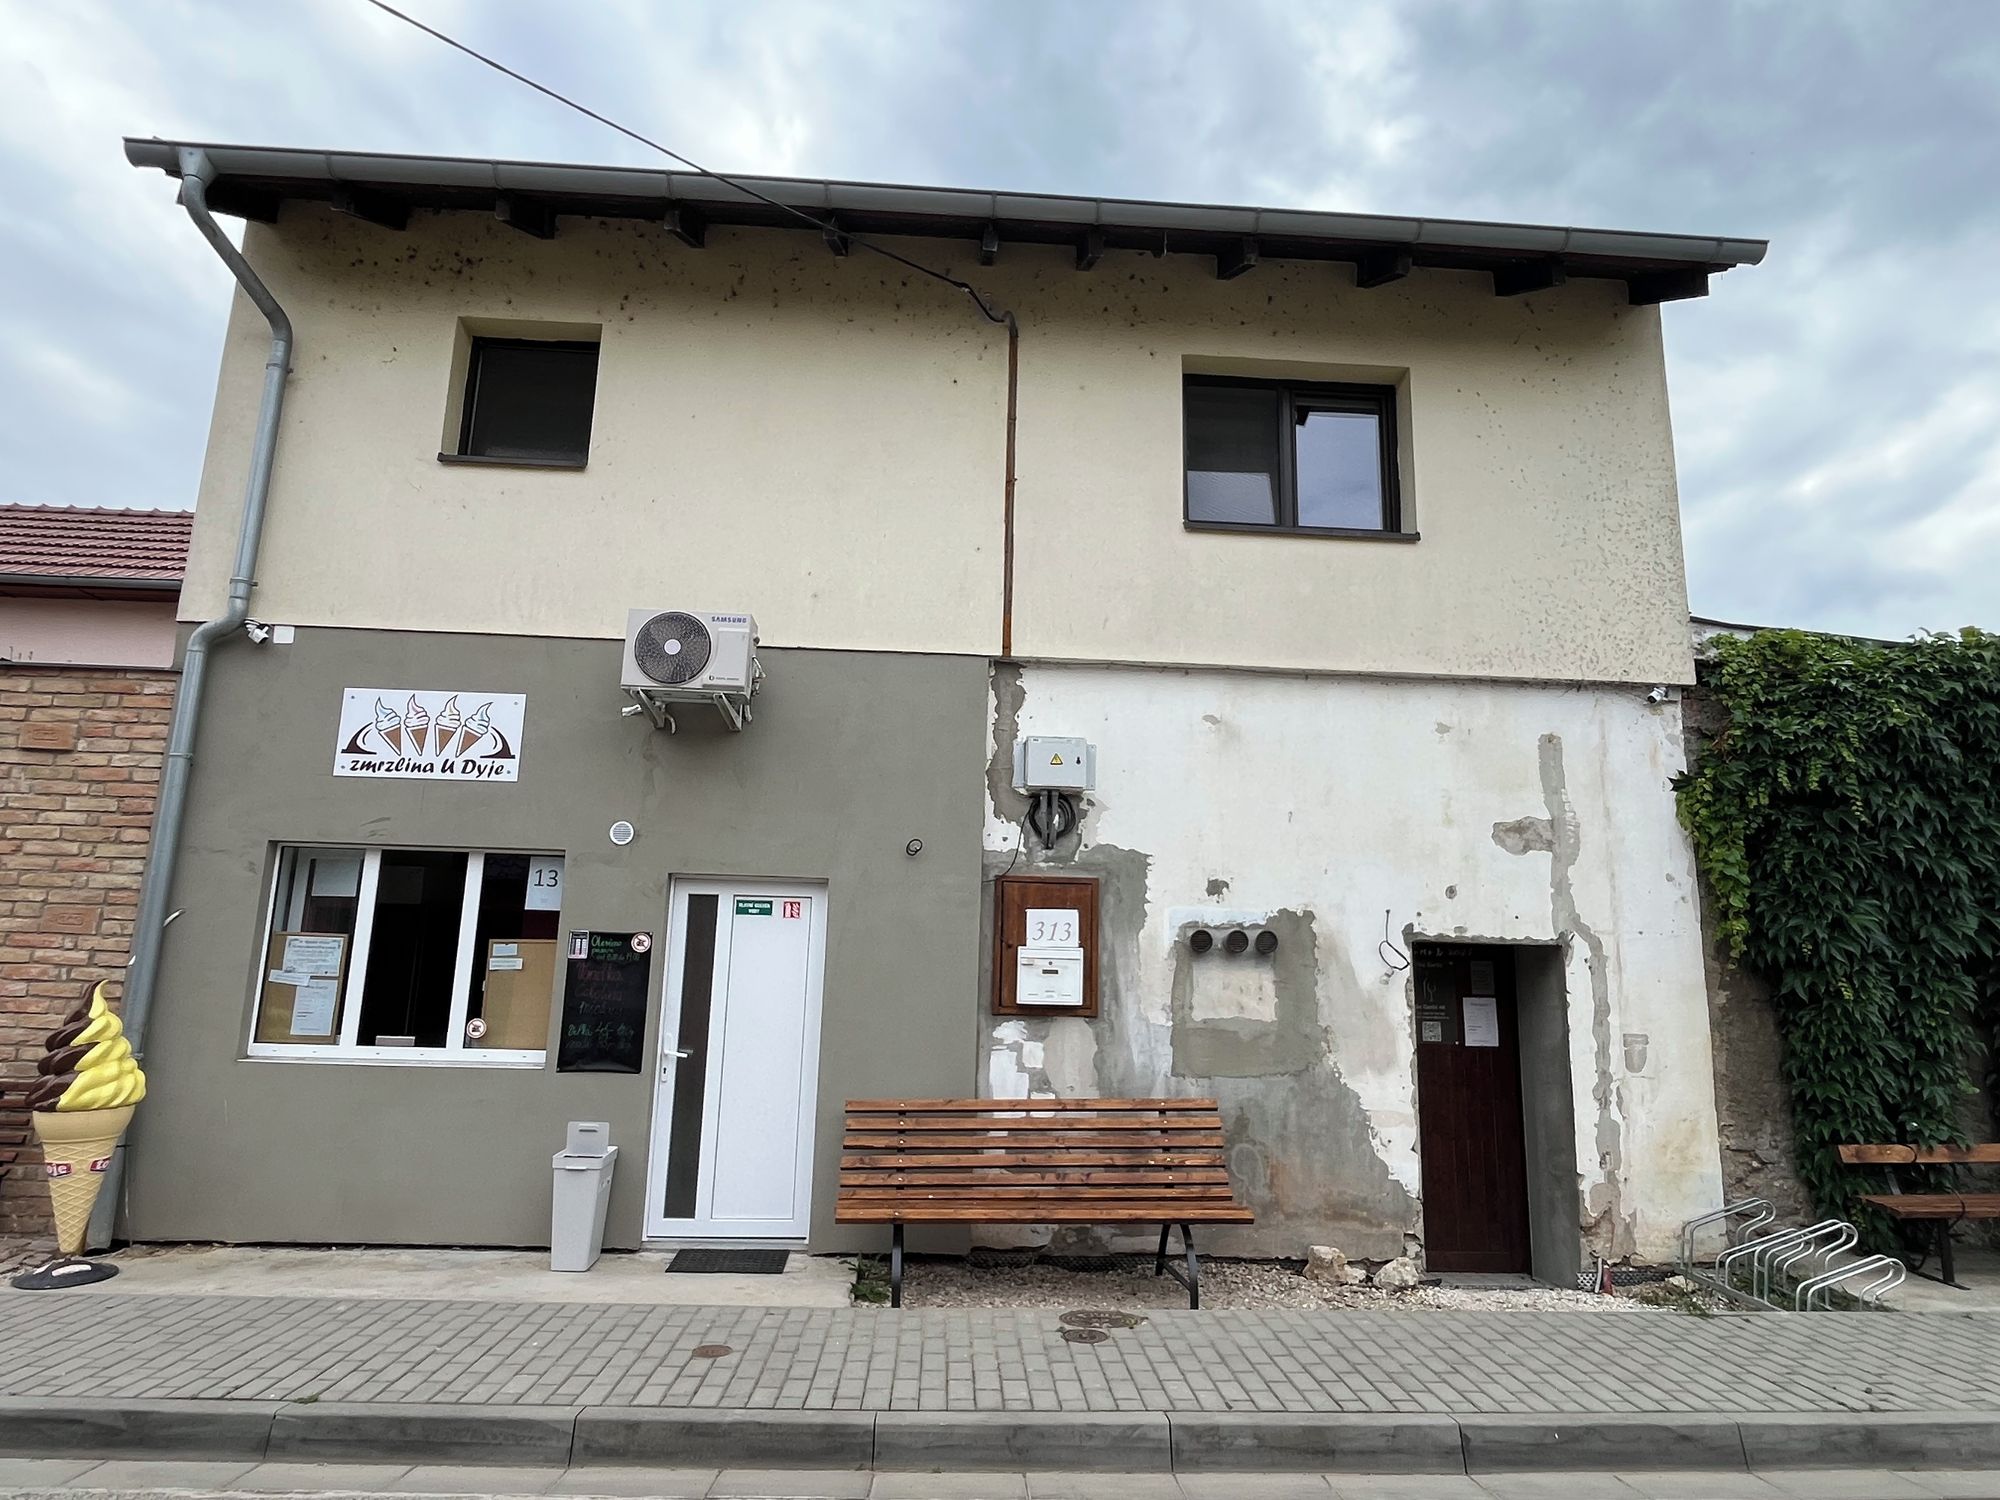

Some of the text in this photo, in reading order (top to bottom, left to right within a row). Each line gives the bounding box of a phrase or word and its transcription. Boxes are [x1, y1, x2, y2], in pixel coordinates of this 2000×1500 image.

[350, 757, 505, 778] zmrzlina U Dyje
[534, 868, 559, 887] 13
[1032, 921, 1072, 942] 313
